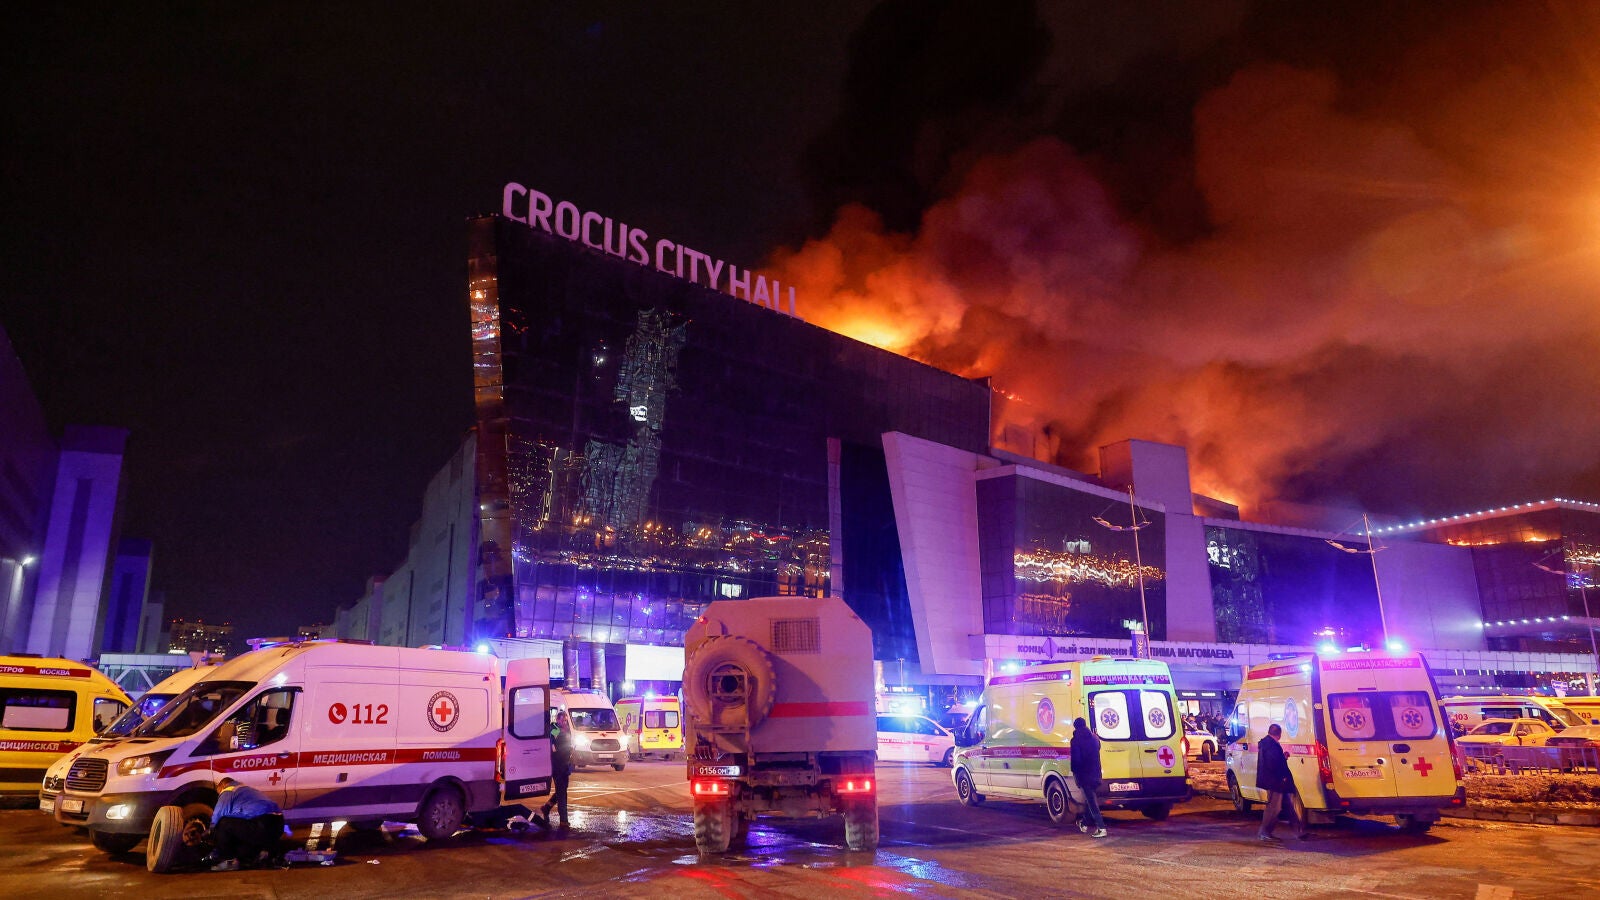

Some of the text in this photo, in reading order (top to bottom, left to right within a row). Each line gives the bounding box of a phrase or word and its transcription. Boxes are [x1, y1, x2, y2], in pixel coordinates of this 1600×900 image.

[502, 182, 803, 320] CROCUS CITY HALL
[1017, 644, 1077, 655] концный
[1079, 646, 1096, 655] зал
[1097, 647, 1128, 656] имени
[1177, 648, 1234, 659] МАГОМАЕВА
[1329, 661, 1370, 669] МЕДИЦИНА
[39, 668, 70, 676] МОСКВА
[1083, 675, 1128, 683] МЕДИЦИНА
[351, 703, 389, 725] 112
[1454, 713, 1469, 721] 103
[232, 751, 461, 769] СКОРАЯ МЕДИЦИНСКАЯ ПОМОЩЬ
